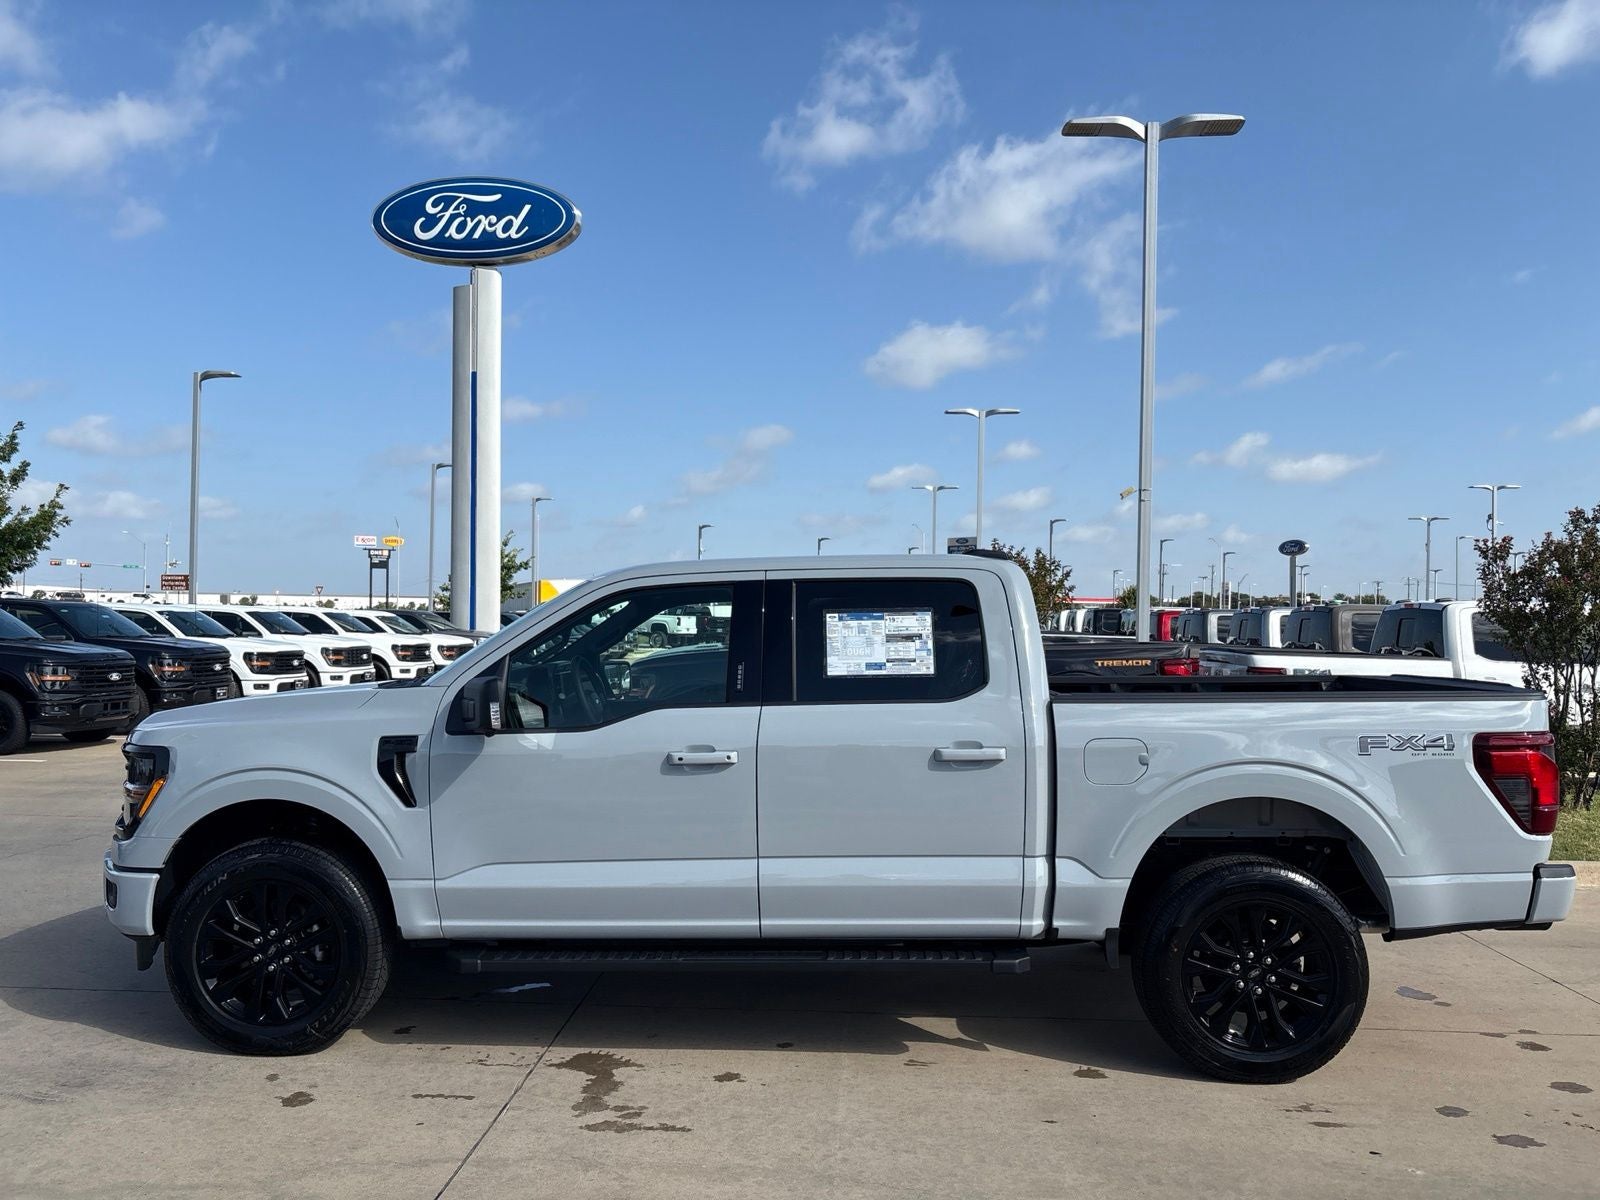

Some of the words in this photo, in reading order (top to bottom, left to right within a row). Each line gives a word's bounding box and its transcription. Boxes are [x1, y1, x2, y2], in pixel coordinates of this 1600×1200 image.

[413, 192, 532, 240] Ford
[1094, 659, 1152, 667] TREMOR
[1358, 733, 1455, 756] FX4
